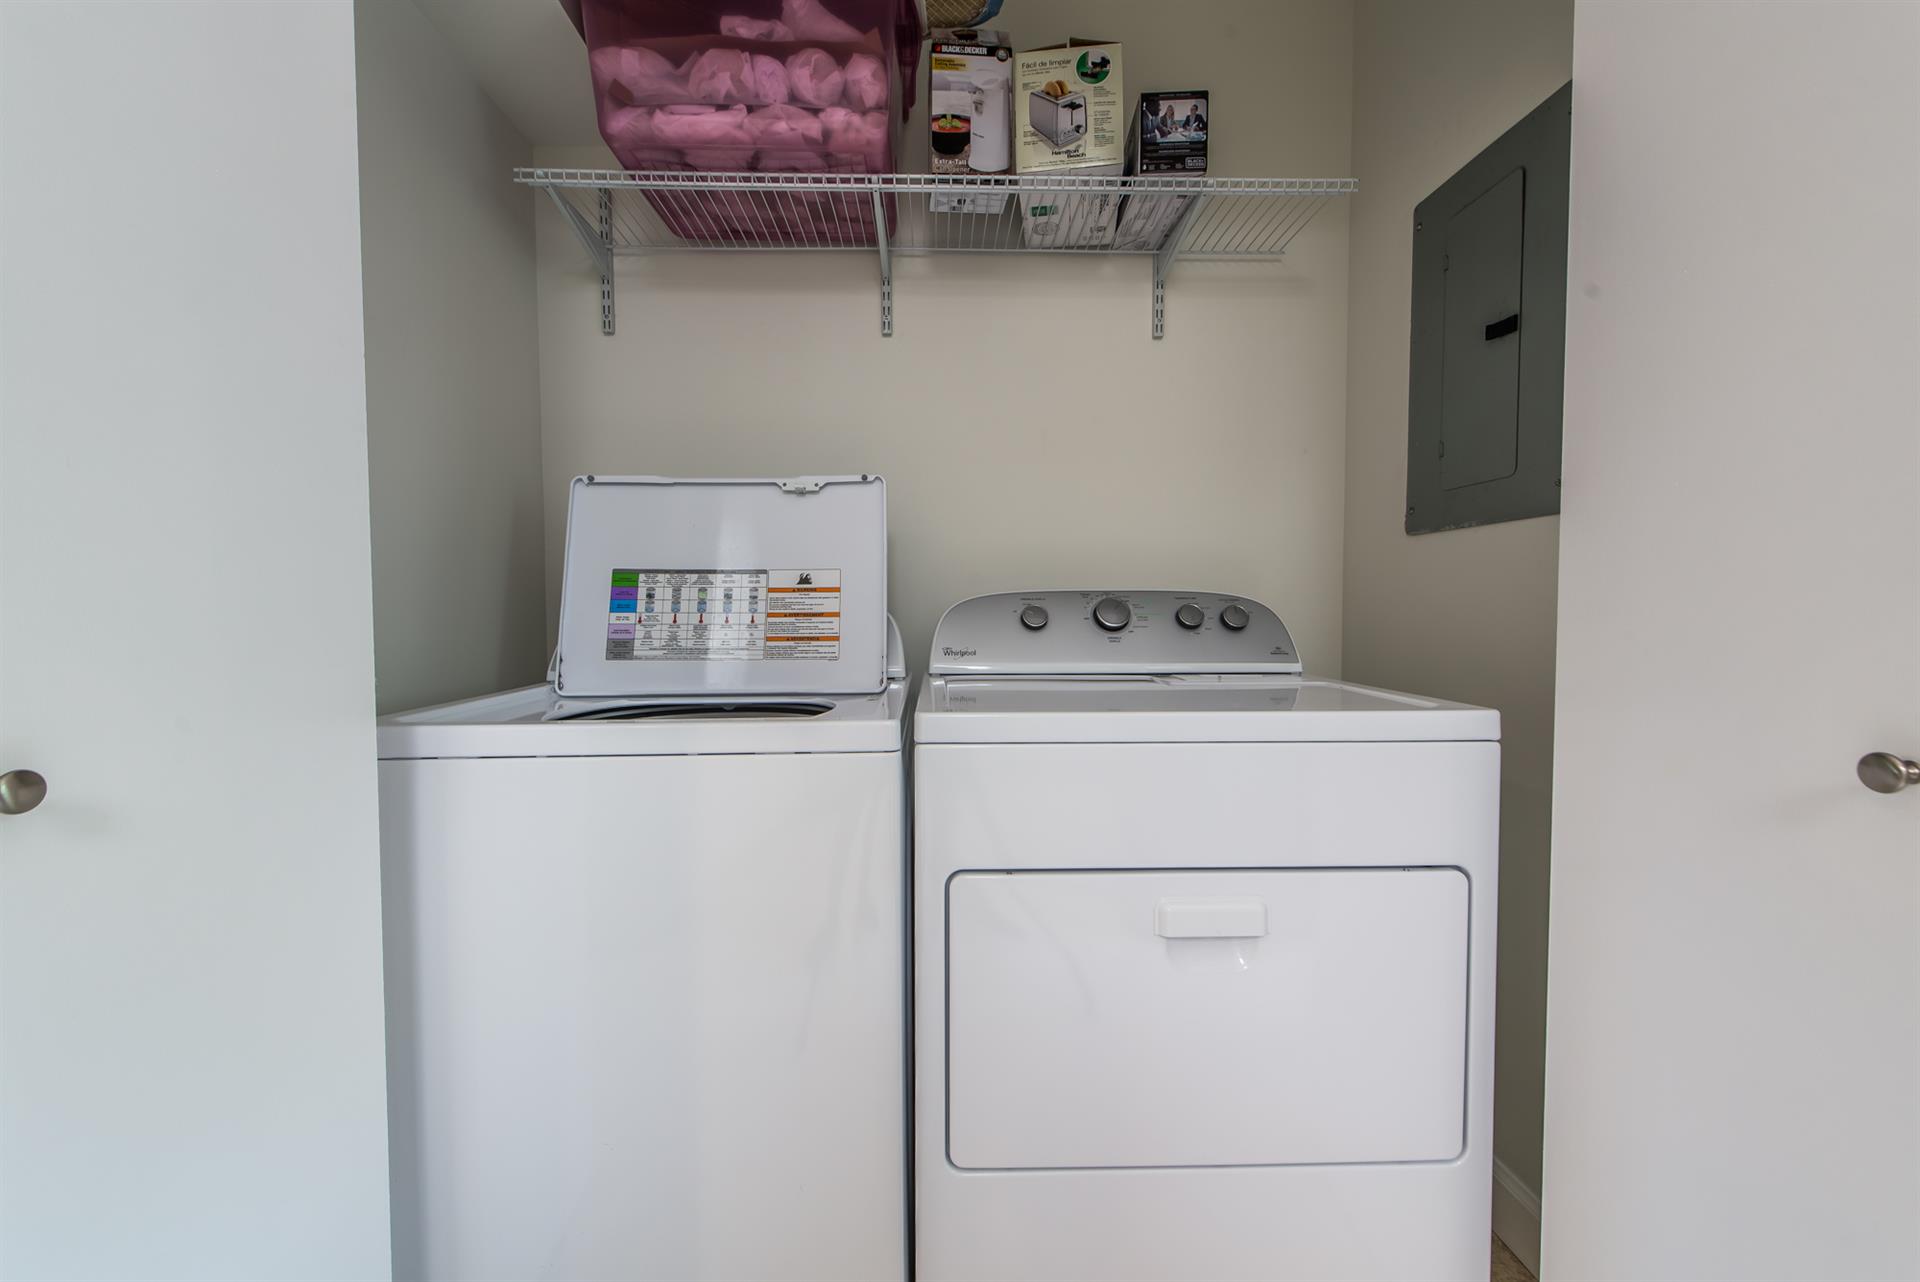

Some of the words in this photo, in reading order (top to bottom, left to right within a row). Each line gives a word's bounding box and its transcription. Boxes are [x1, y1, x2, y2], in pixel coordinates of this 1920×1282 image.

[941, 45, 988, 55] BLACK&DECKER
[1021, 60, 1037, 69] Fácil
[1038, 60, 1048, 68] de
[1049, 57, 1072, 67] limpiar
[1051, 148, 1080, 156] Hamilton
[934, 158, 967, 166] Extra-Tall
[943, 648, 977, 658] Whirlpool
